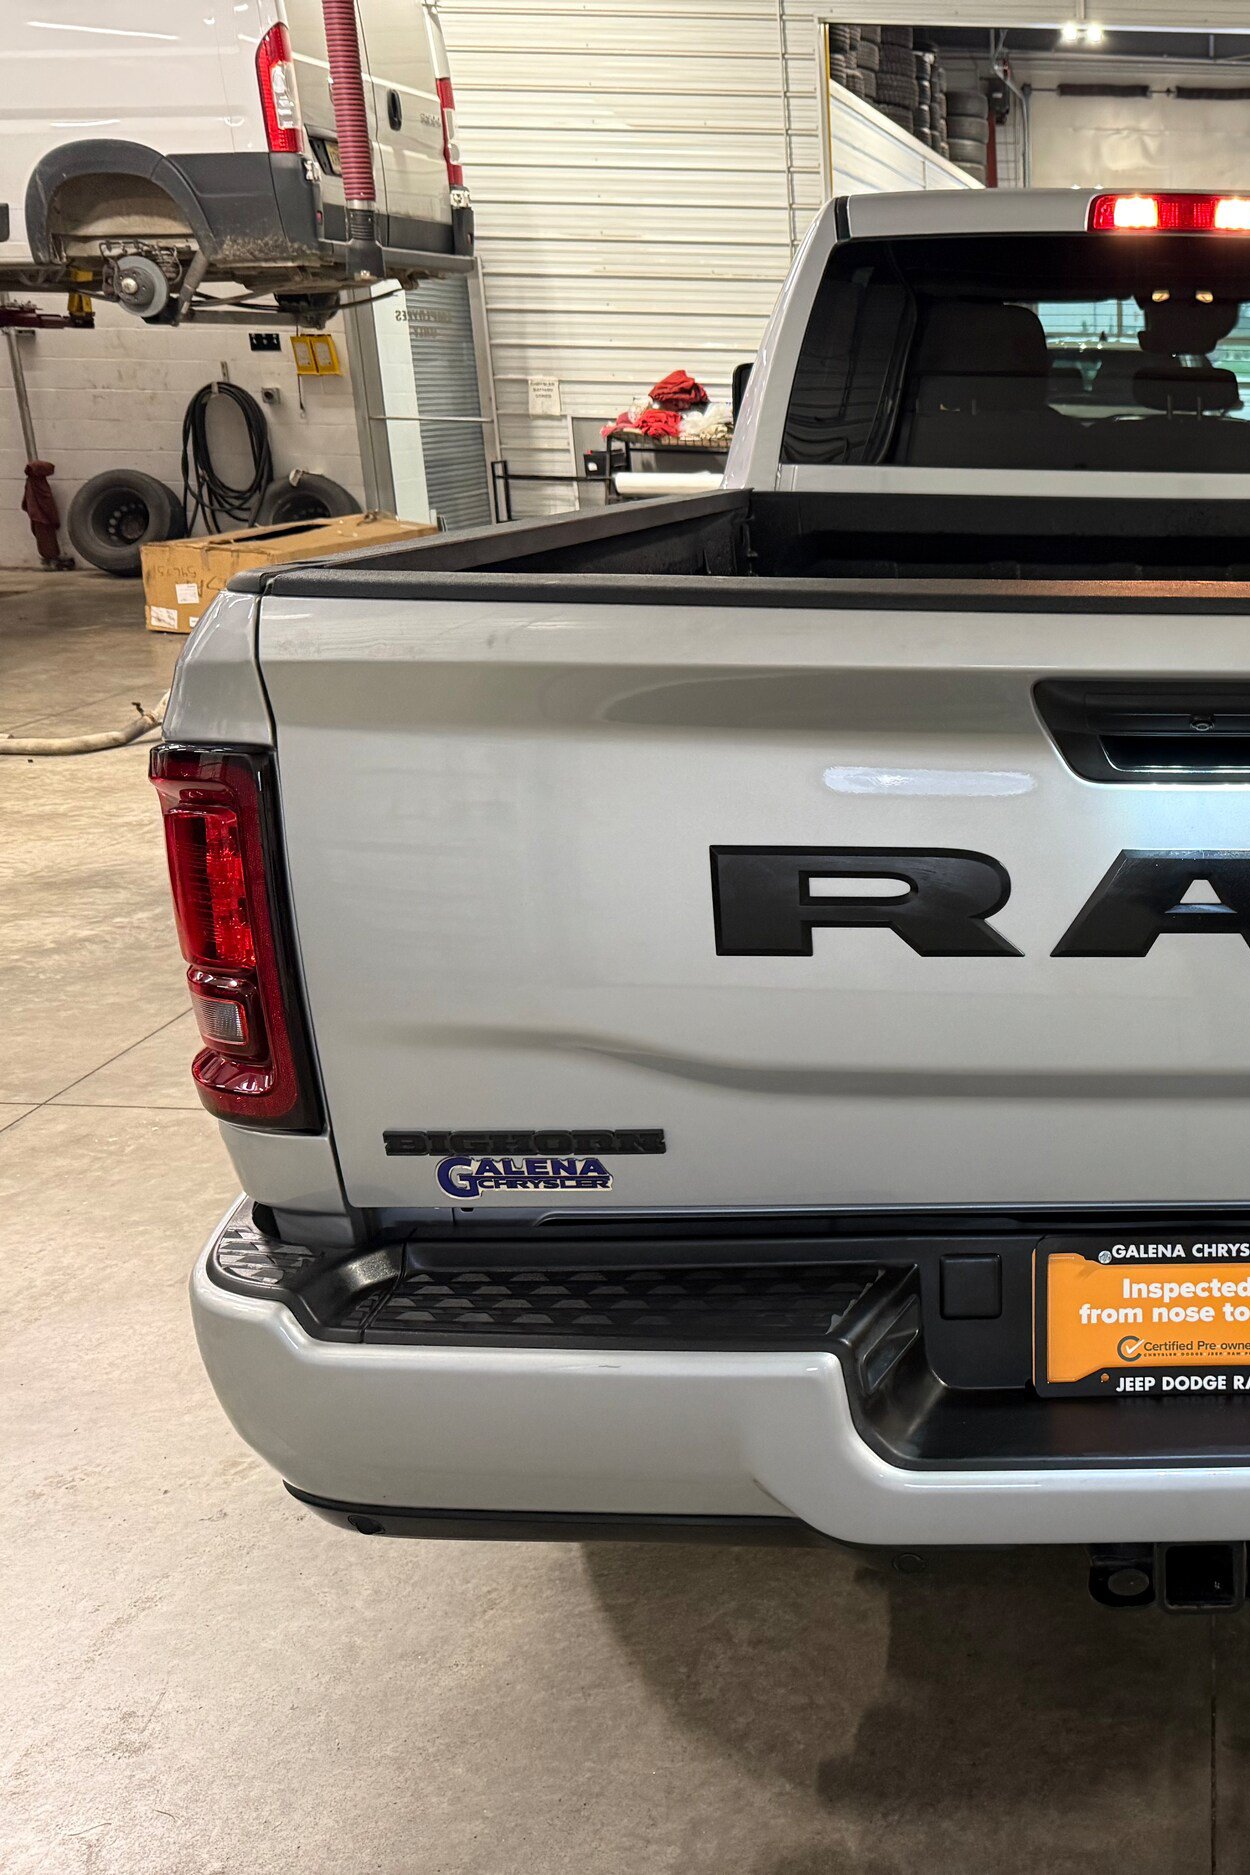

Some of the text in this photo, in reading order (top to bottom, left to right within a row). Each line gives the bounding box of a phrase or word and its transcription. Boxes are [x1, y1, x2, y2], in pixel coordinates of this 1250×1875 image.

[383, 1129, 667, 1156] BIGHORN
[436, 1156, 609, 1199] GALENA
[478, 1179, 611, 1190] CHRYSLER
[1112, 1244, 1186, 1259] GALENA
[1079, 1304, 1143, 1324] from
[1152, 1306, 1215, 1323] nose
[1223, 1303, 1250, 1322] to
[1143, 1340, 1194, 1352] Certified
[1116, 1377, 1156, 1392] JEEP
[1162, 1375, 1227, 1391] DODGE
